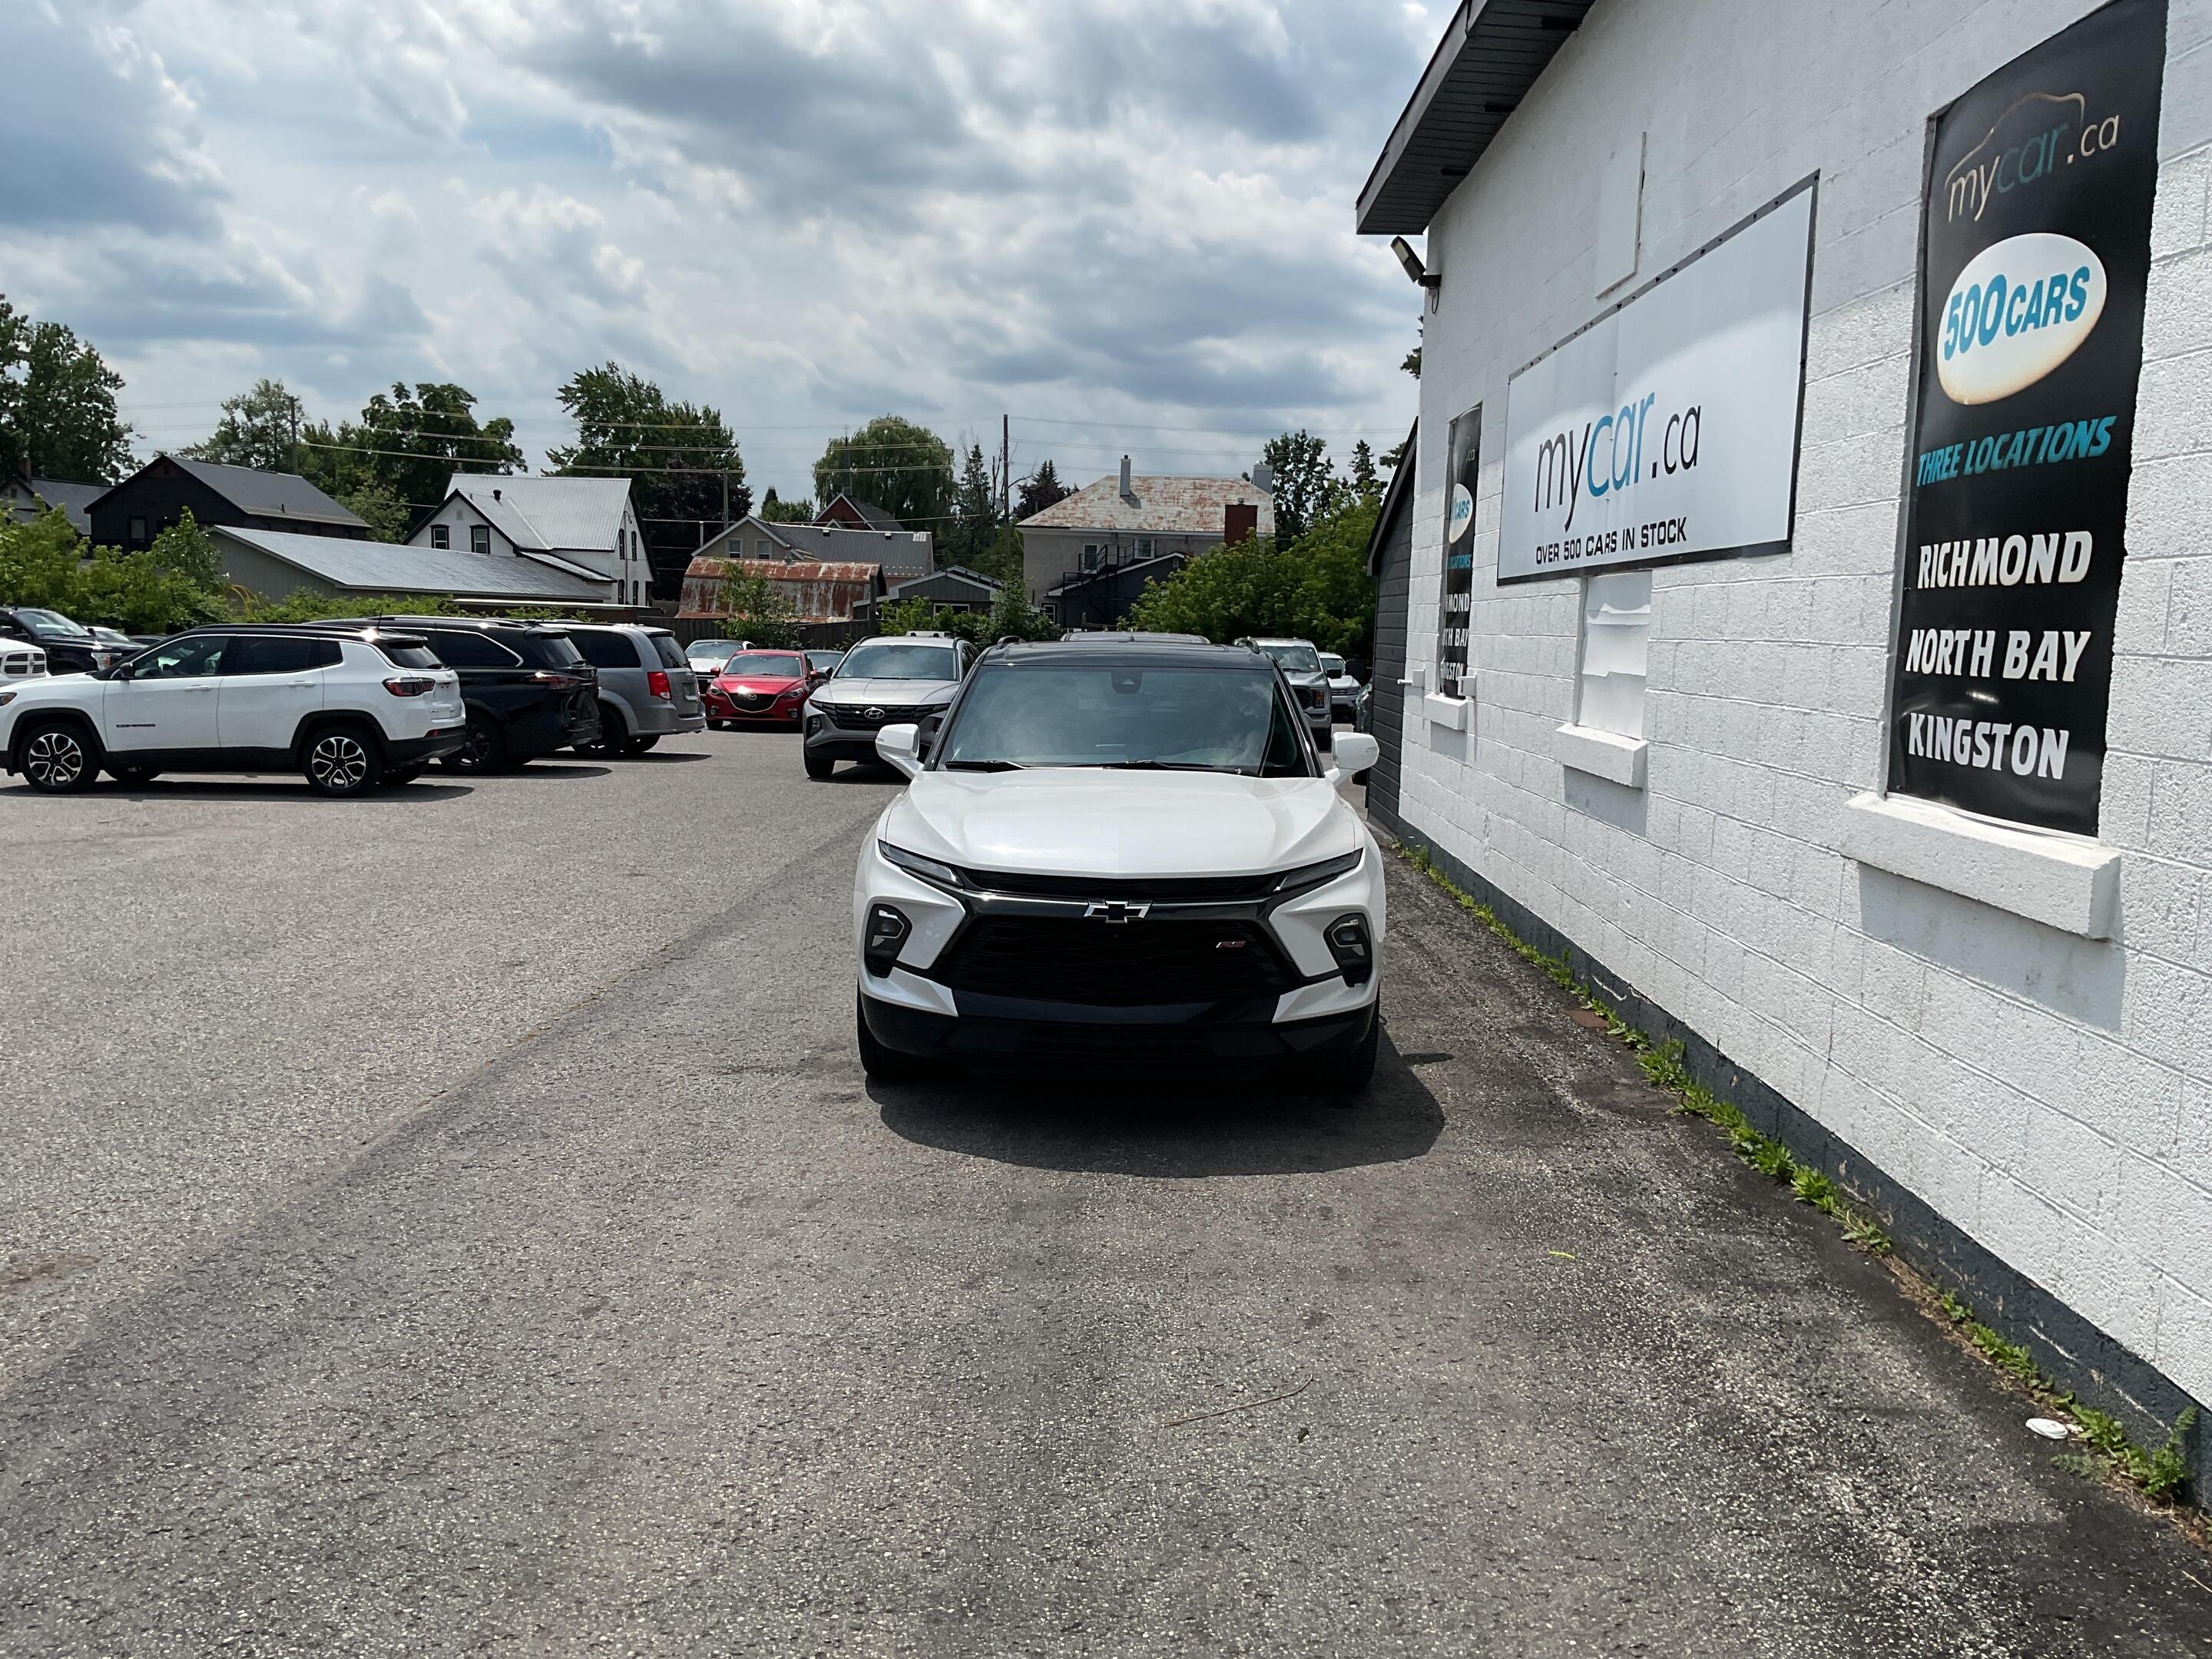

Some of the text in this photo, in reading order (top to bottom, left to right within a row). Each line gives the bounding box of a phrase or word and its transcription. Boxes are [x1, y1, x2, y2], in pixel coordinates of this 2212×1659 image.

[1946, 114, 2120, 223] mycar.ca
[1535, 392, 1701, 532] mycar.ca
[1916, 415, 2118, 487] THREE LOCATIONS
[1536, 516, 1687, 565] OVER 500 CARS IN STOCK
[1917, 531, 2093, 589] RICHMOND
[1454, 628, 1469, 647] BAY
[1906, 628, 2091, 682] NORTH BAY
[1908, 712, 2070, 780] KINGSTON
